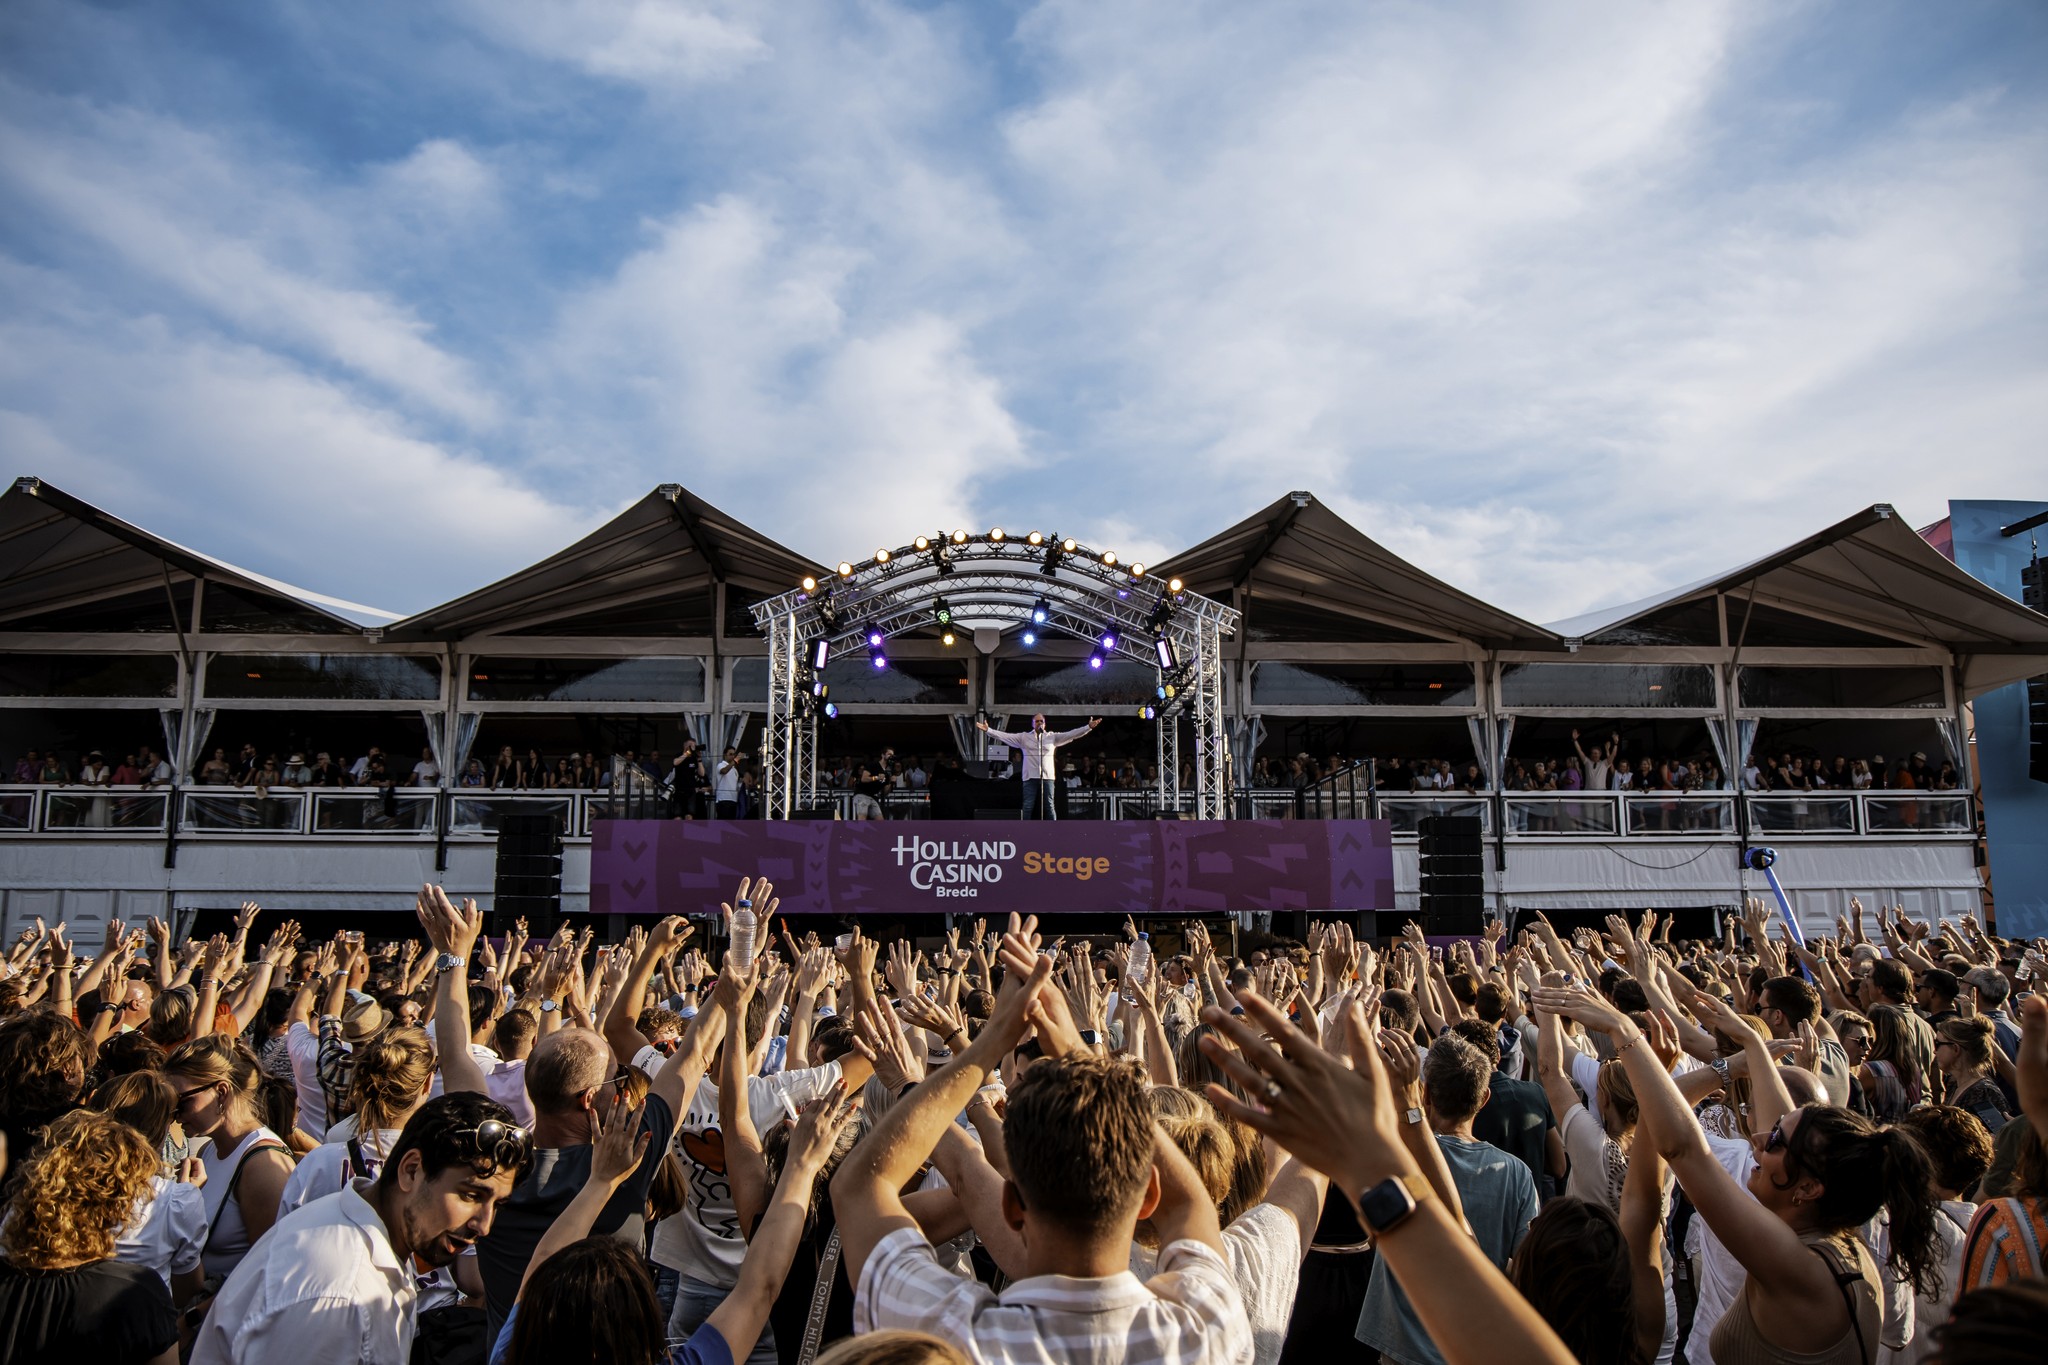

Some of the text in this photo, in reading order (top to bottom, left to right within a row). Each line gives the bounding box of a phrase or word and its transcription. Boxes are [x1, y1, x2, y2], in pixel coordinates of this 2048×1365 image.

[890, 835, 1017, 866] HOLLAND
[910, 861, 1003, 890] CASINO
[1023, 851, 1110, 881] Stage
[936, 885, 978, 897] Breda
[825, 1229, 841, 1261] IGER
[811, 1281, 829, 1324] TOMMY
